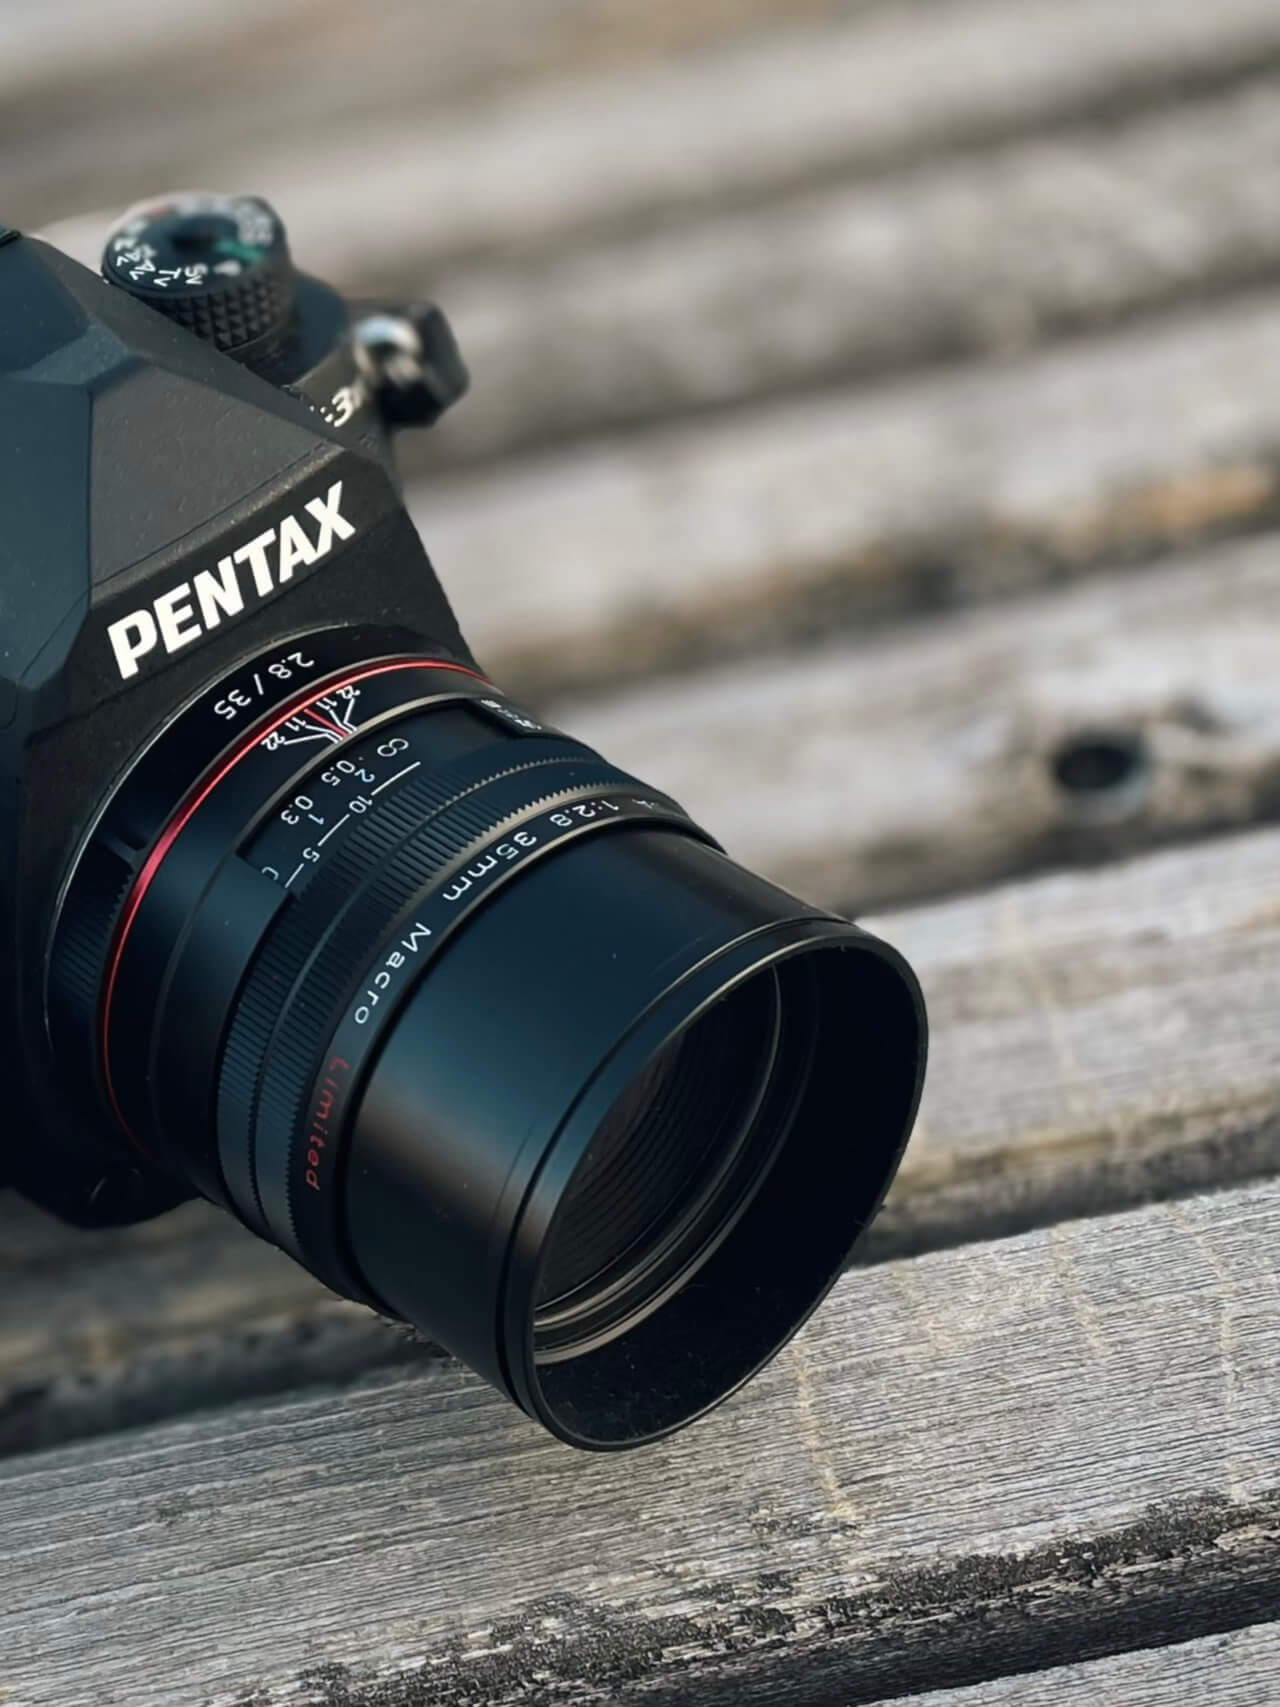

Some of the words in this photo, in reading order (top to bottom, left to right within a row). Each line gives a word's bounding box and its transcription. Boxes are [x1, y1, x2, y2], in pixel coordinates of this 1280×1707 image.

[107, 480, 356, 680] PENTAX
[285, 717, 308, 731] 11
[321, 760, 356, 786] 0.5
[354, 768, 376, 783] 2
[281, 795, 313, 825] 0.3
[348, 795, 373, 814] 10
[549, 799, 620, 827] 1:2.8
[302, 847, 320, 863] 5
[442, 831, 537, 901] 35mm
[354, 922, 432, 1025] Macro
[306, 1055, 352, 1191] Limited
